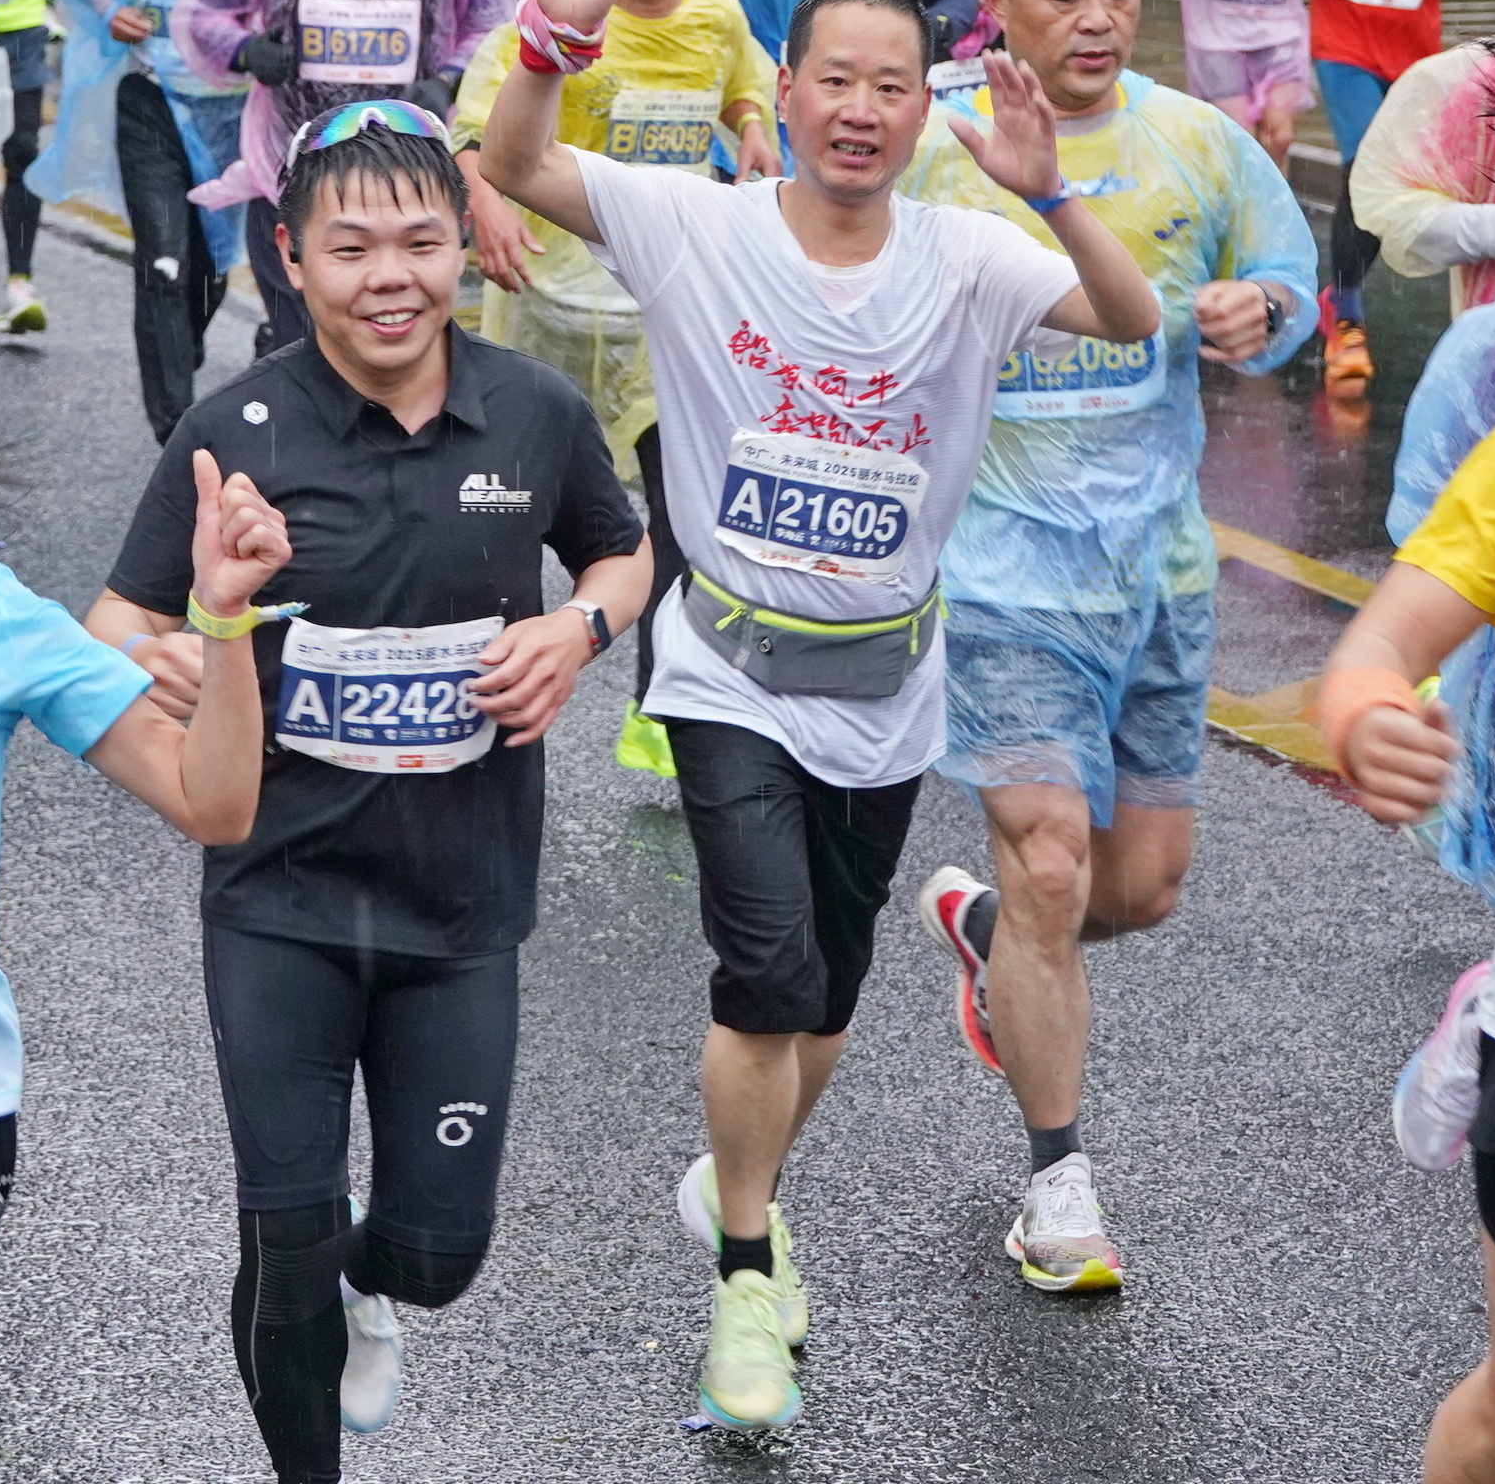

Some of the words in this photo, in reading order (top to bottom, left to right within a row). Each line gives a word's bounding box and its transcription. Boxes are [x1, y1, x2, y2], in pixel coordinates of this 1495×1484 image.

[302, 27, 324, 57] B
[330, 29, 406, 56] 61716
[610, 123, 637, 153] B
[459, 473, 507, 490] ALL
[459, 490, 533, 503] WEATHER
[726, 477, 764, 524] A
[774, 488, 902, 542] 21605
[285, 677, 331, 726] A
[341, 677, 480, 726] 22428
